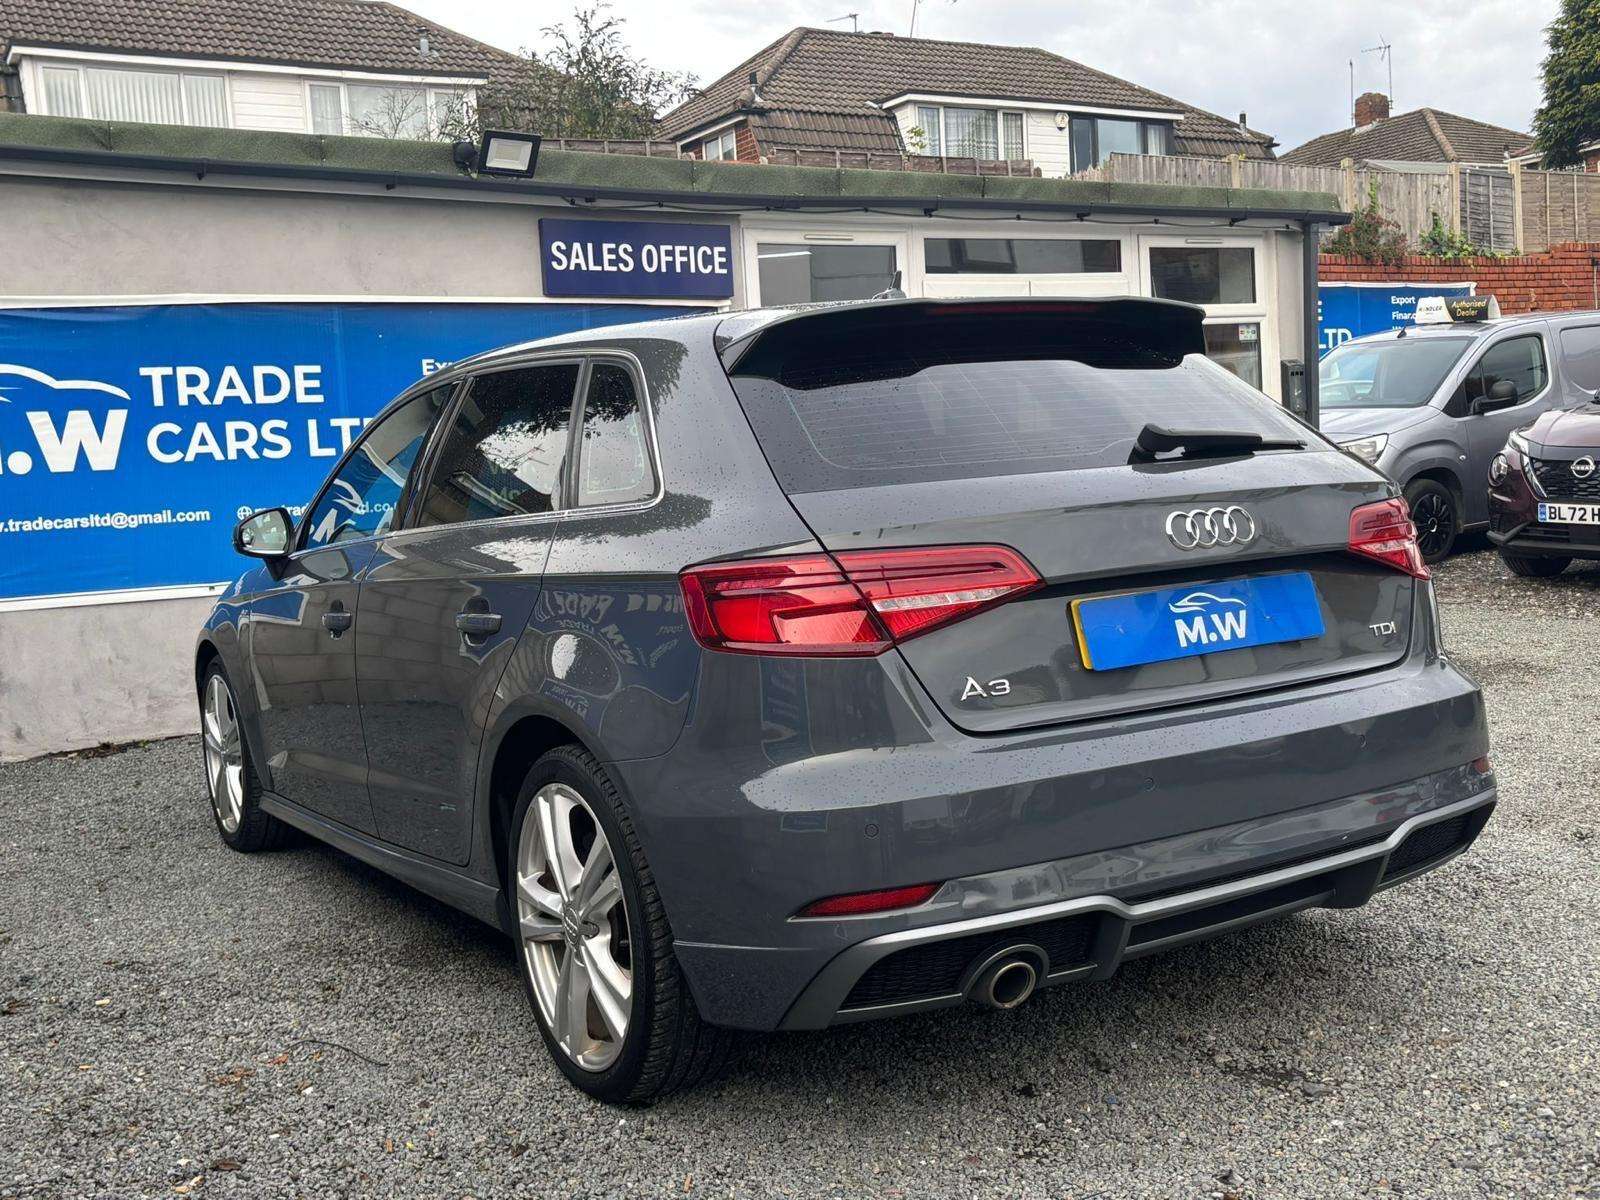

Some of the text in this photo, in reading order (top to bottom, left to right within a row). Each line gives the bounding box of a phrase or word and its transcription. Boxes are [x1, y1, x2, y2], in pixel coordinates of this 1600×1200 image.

[551, 241, 727, 274] SALES OFFICE
[1391, 296, 1416, 305] Export
[1456, 308, 1478, 317] Dealer
[139, 364, 324, 407] TRADE
[0, 408, 128, 476] .W
[146, 417, 374, 463] CARS LT
[1548, 505, 1587, 521] BL72
[1174, 609, 1247, 648] M.W
[1369, 621, 1397, 636] TDI
[960, 676, 1011, 702] A3
